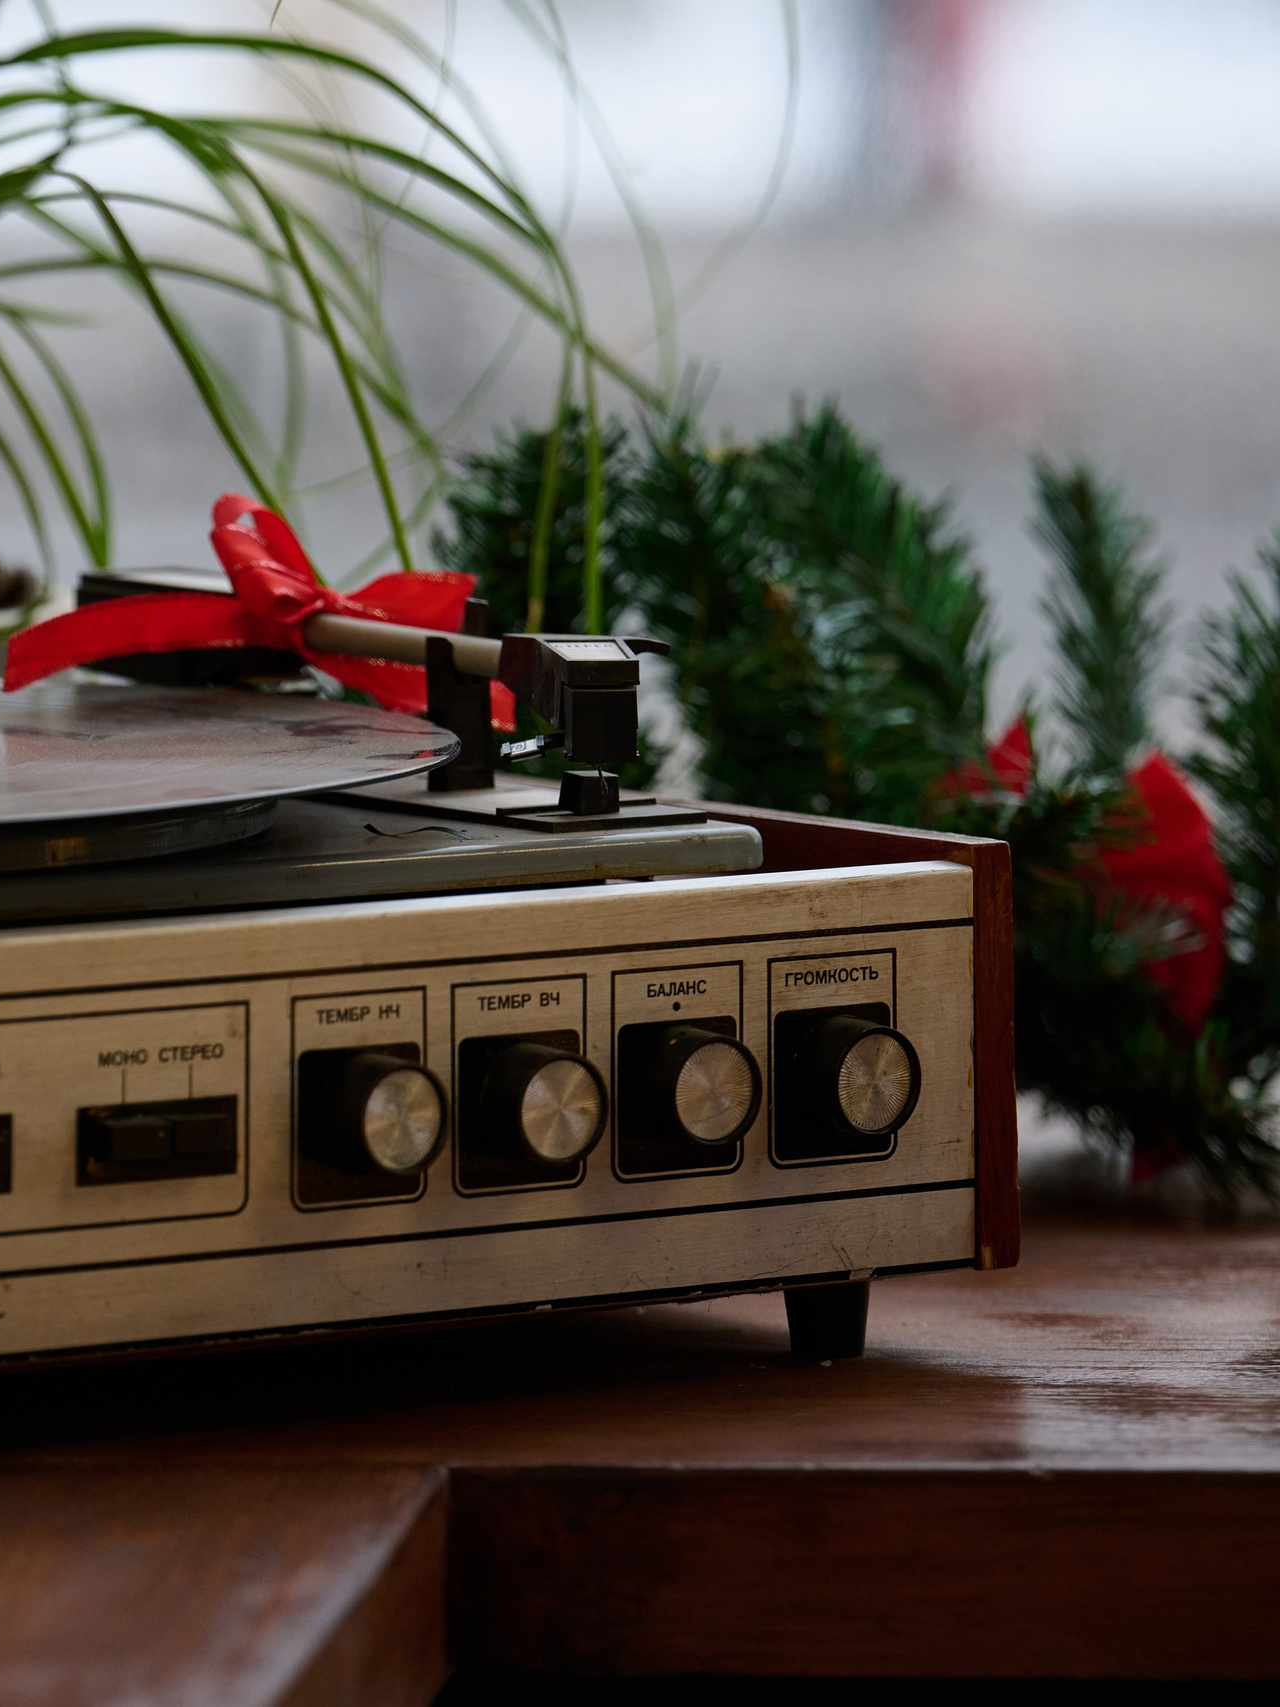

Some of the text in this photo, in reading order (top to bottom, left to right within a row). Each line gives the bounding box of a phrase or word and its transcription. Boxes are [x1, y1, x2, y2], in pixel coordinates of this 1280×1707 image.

[784, 966, 880, 987] ГРОМКОСТЬ
[646, 979, 708, 998] БАЛАНС
[476, 991, 561, 1012] ТЕМБР ВЧ
[315, 1003, 401, 1025] ТЕМБР НЧ
[97, 1042, 225, 1068] МОНО СТЕРЕО
